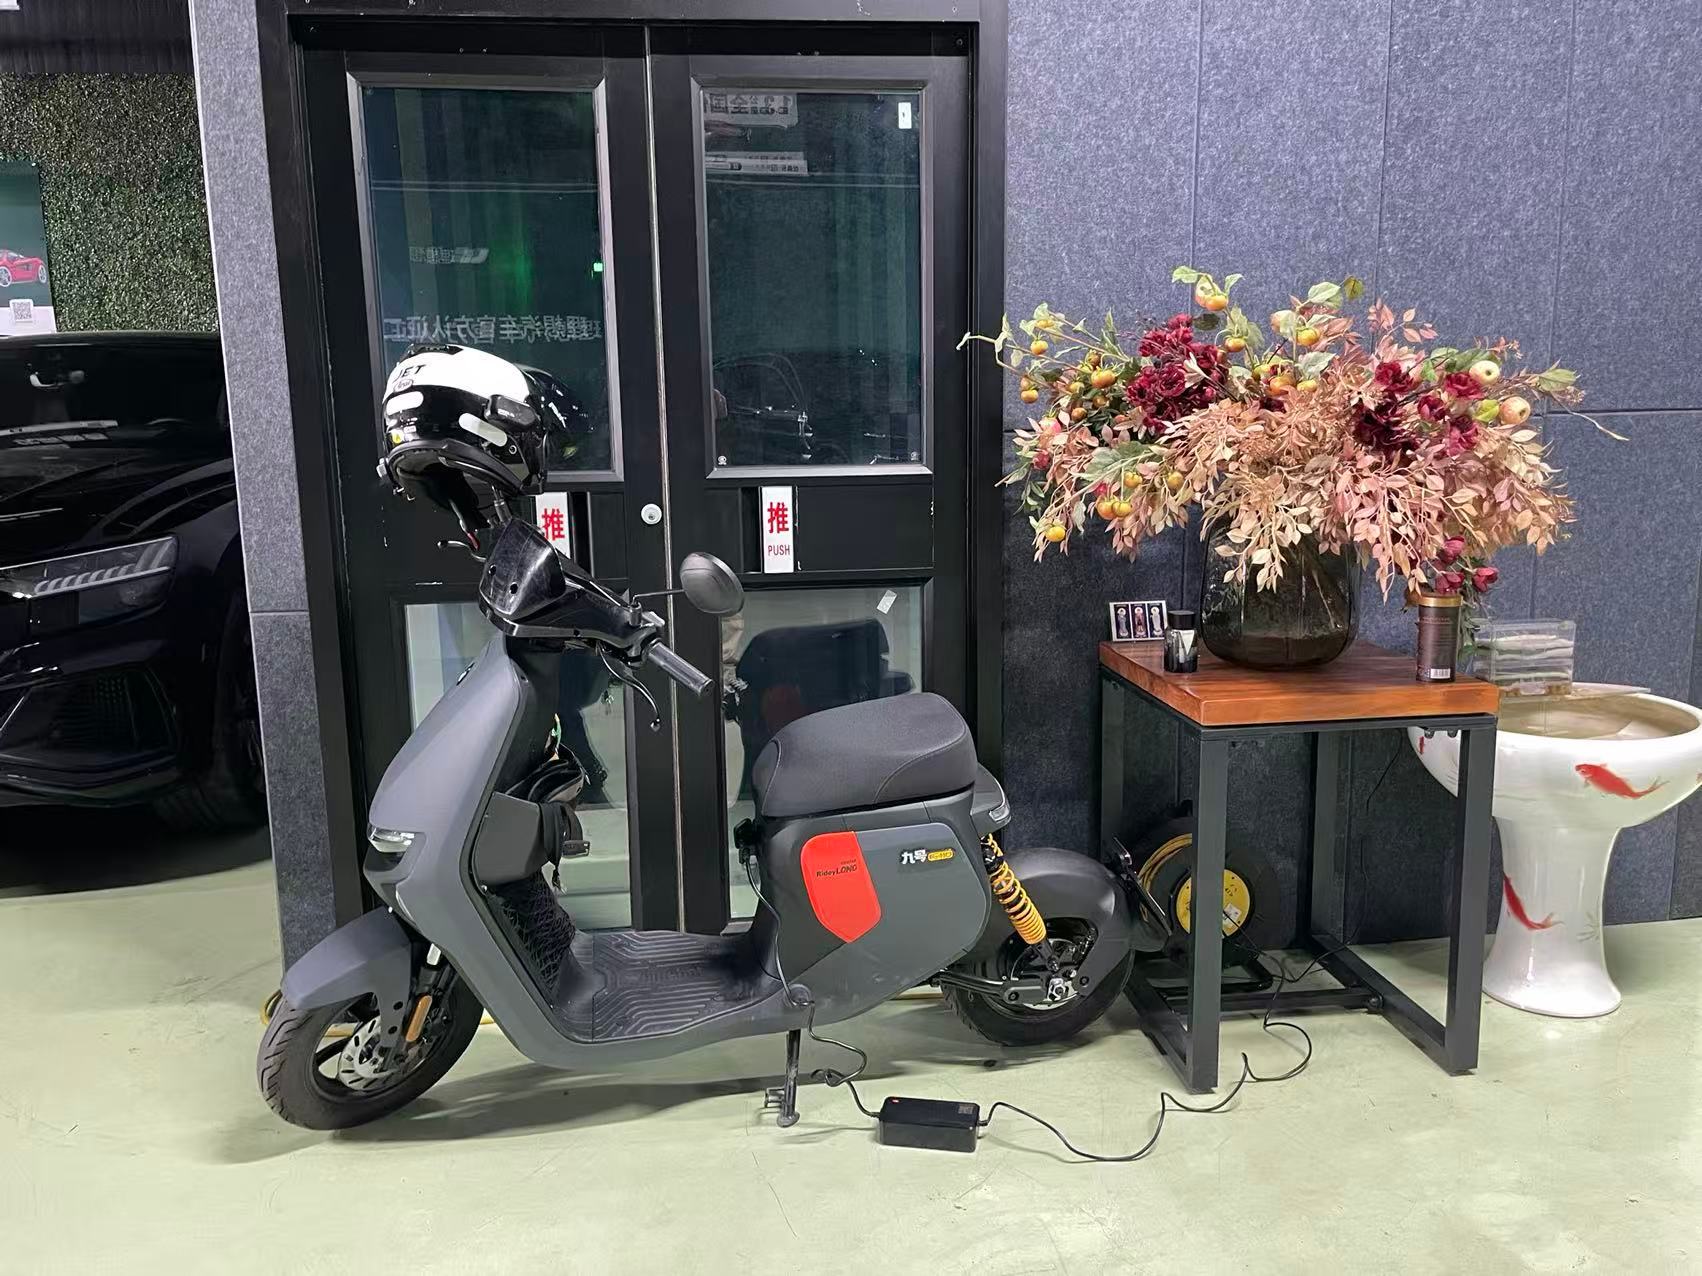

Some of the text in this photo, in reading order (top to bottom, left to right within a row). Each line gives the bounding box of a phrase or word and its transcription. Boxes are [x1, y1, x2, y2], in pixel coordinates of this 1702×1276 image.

[541, 507, 565, 541] 推
[767, 501, 790, 534] 推
[767, 544, 791, 556] PUSH
[901, 849, 927, 865] 九号
